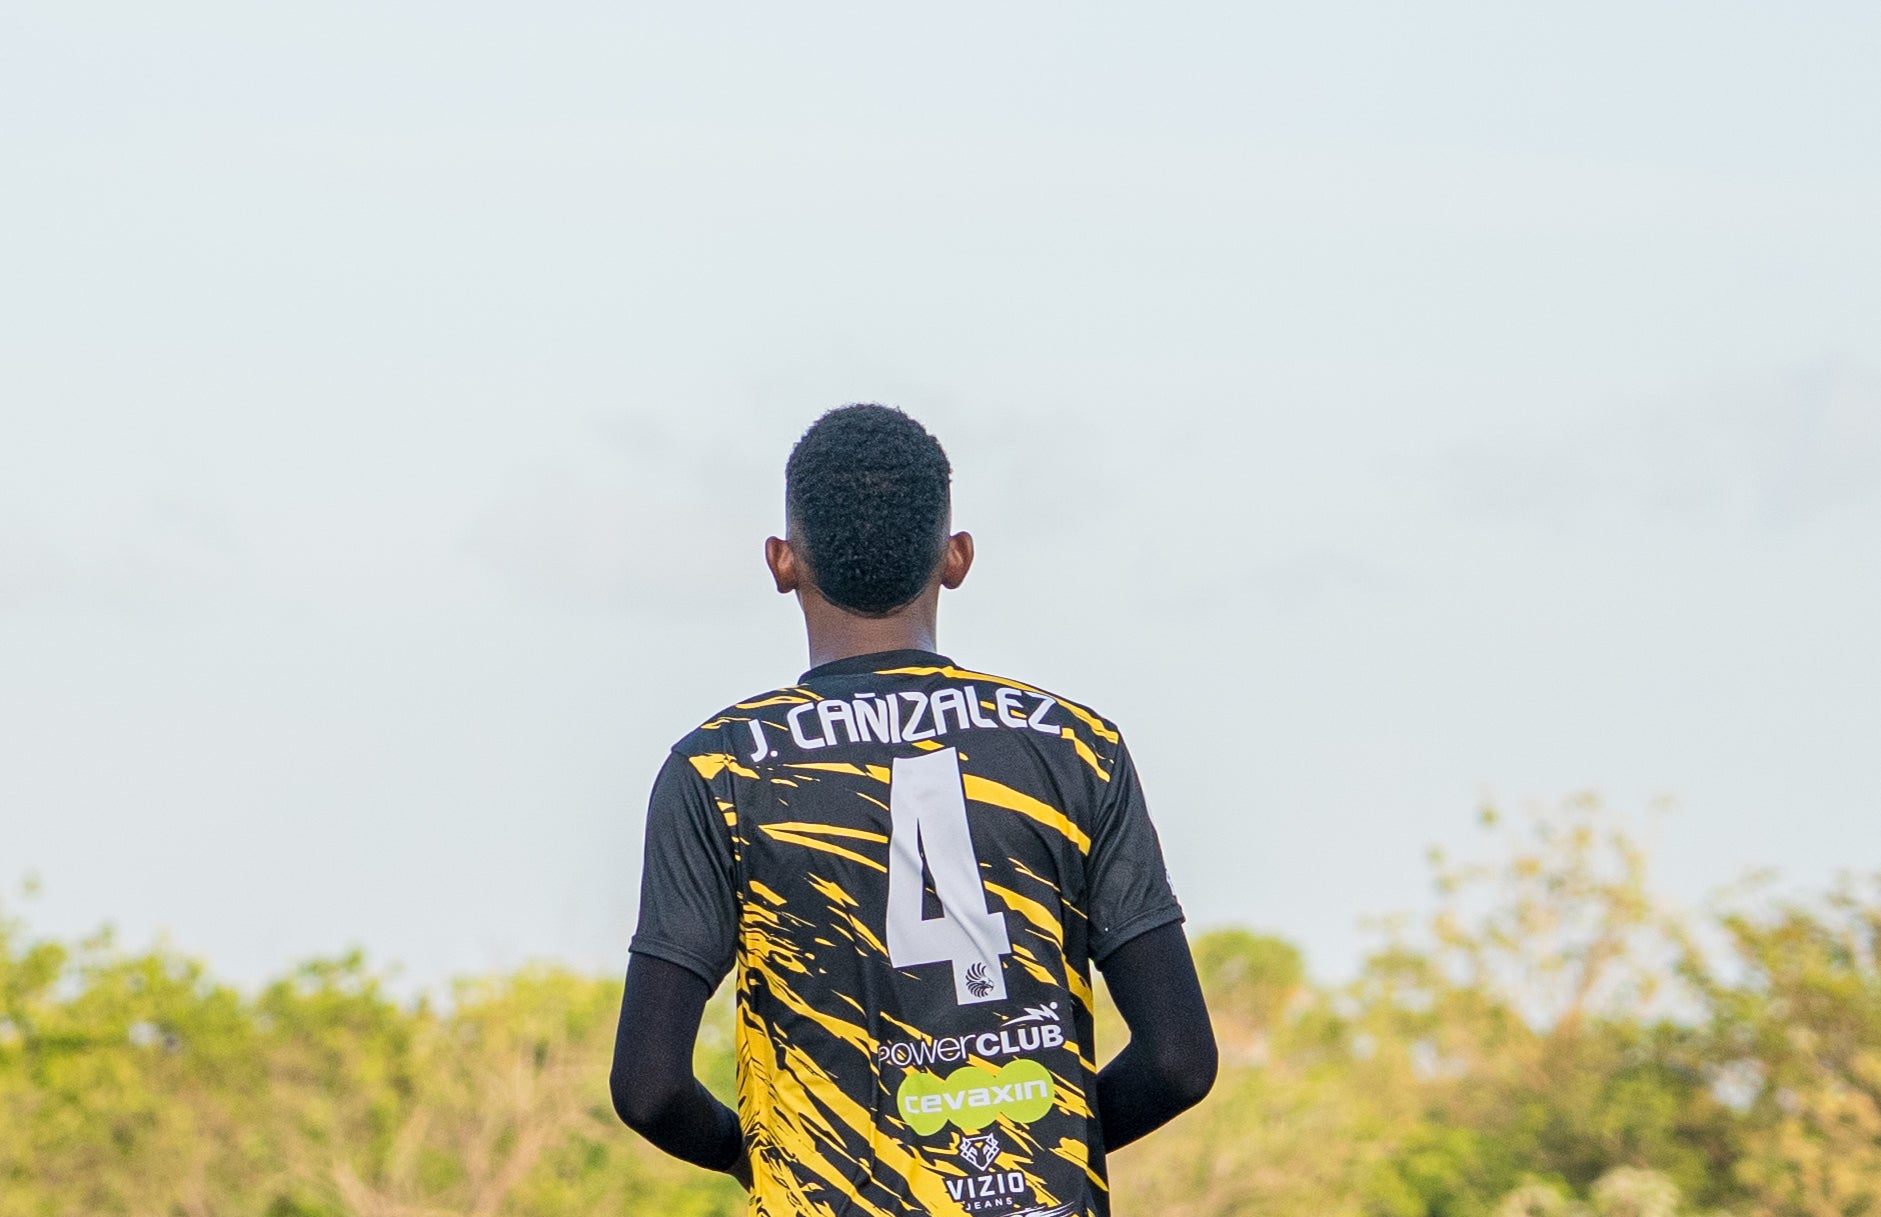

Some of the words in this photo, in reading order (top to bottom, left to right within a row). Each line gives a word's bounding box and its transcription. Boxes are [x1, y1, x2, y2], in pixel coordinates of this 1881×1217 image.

[747, 719, 779, 763] J.
[787, 685, 1062, 750] CAÑIZALEZ
[886, 746, 1012, 1006] 4
[946, 1172, 1025, 1200] VIZIO
[965, 1197, 1014, 1211] JEANS
